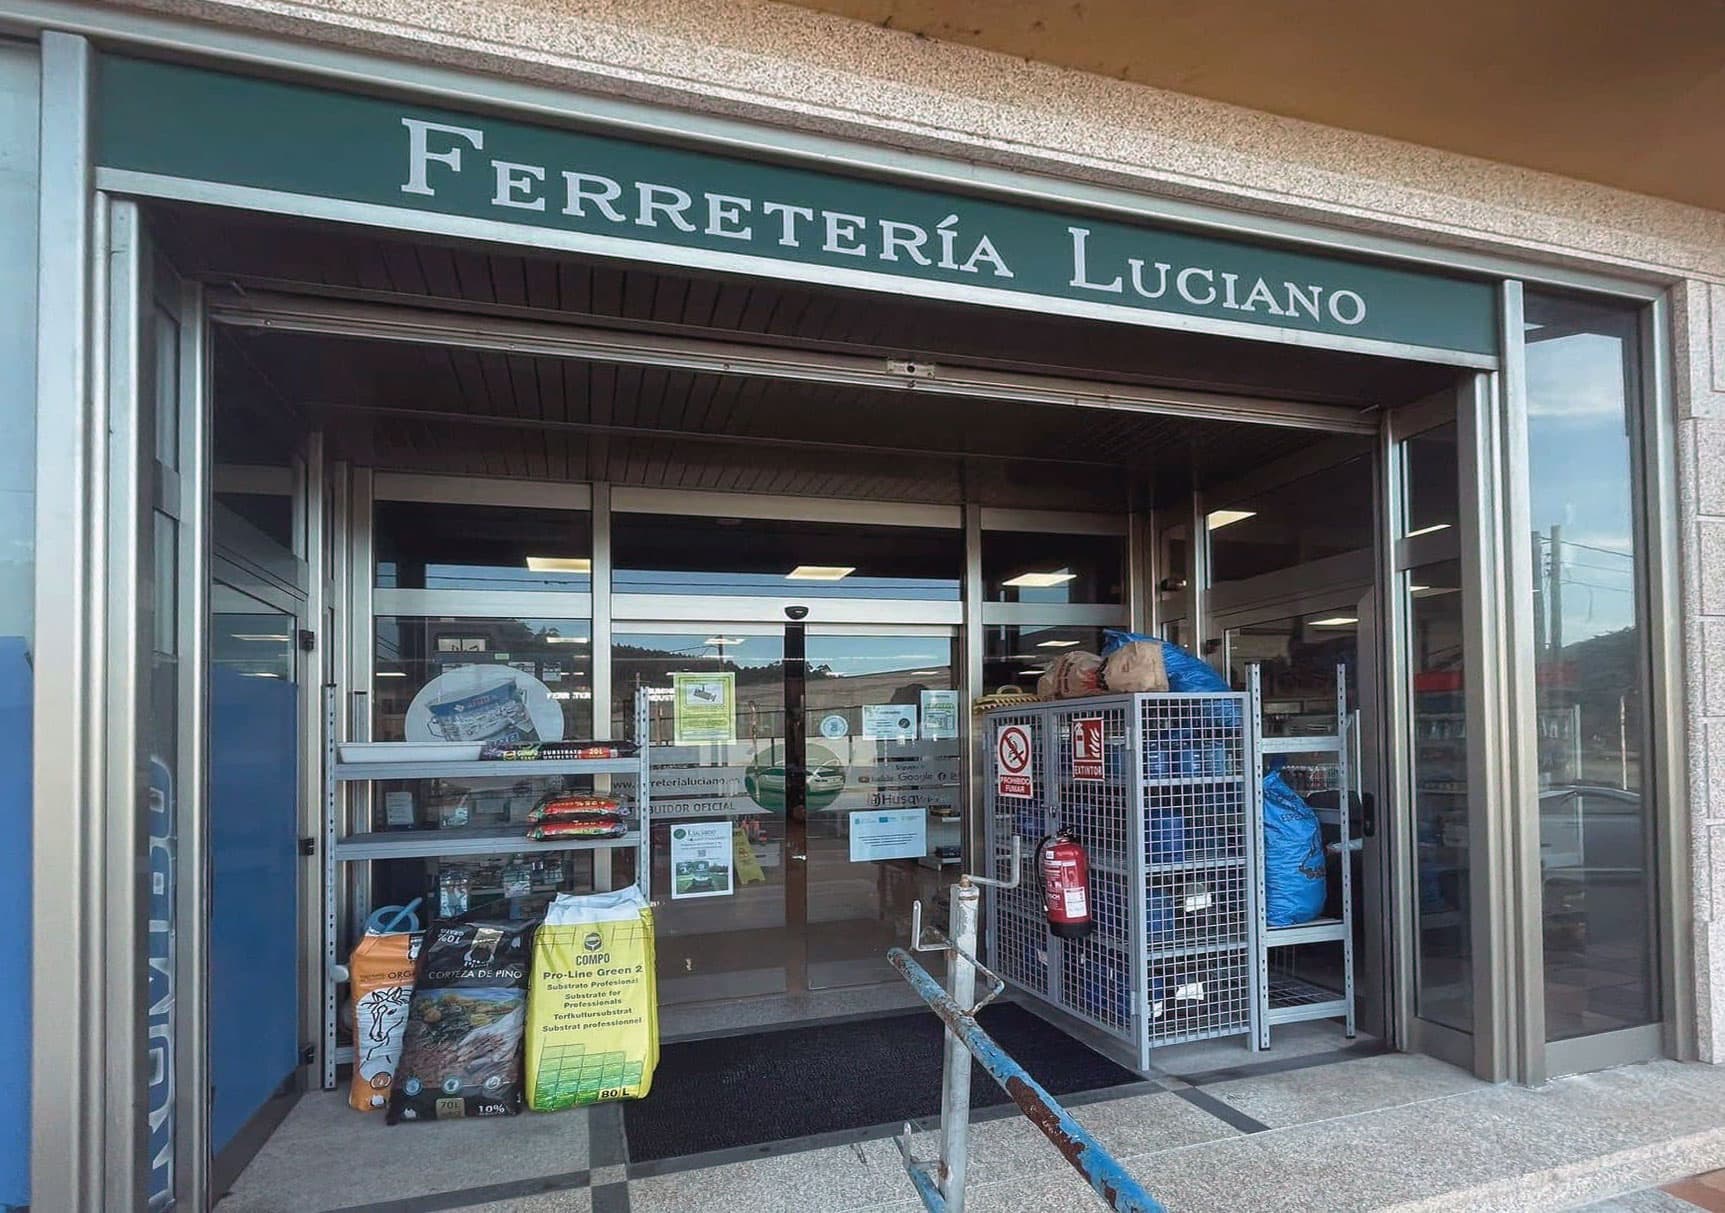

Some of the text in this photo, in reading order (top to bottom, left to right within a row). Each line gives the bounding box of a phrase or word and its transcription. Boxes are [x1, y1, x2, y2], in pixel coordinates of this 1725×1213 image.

[400, 117, 1367, 326] FERRETERÍA LUCIANO
[1074, 765, 1103, 777] EXTINTOR
[576, 953, 610, 966] COMPO
[387, 970, 416, 980] ORG
[428, 969, 522, 979] CORTEZA DE PINO
[543, 965, 643, 980] Pro-Line Green 2
[547, 982, 588, 990] Substrato
[565, 992, 606, 1000] Substrate
[564, 999, 622, 1008] Professionals
[542, 1023, 580, 1032] Substrat
[601, 1088, 630, 1098] 80 L
[478, 1104, 505, 1114] 10%
